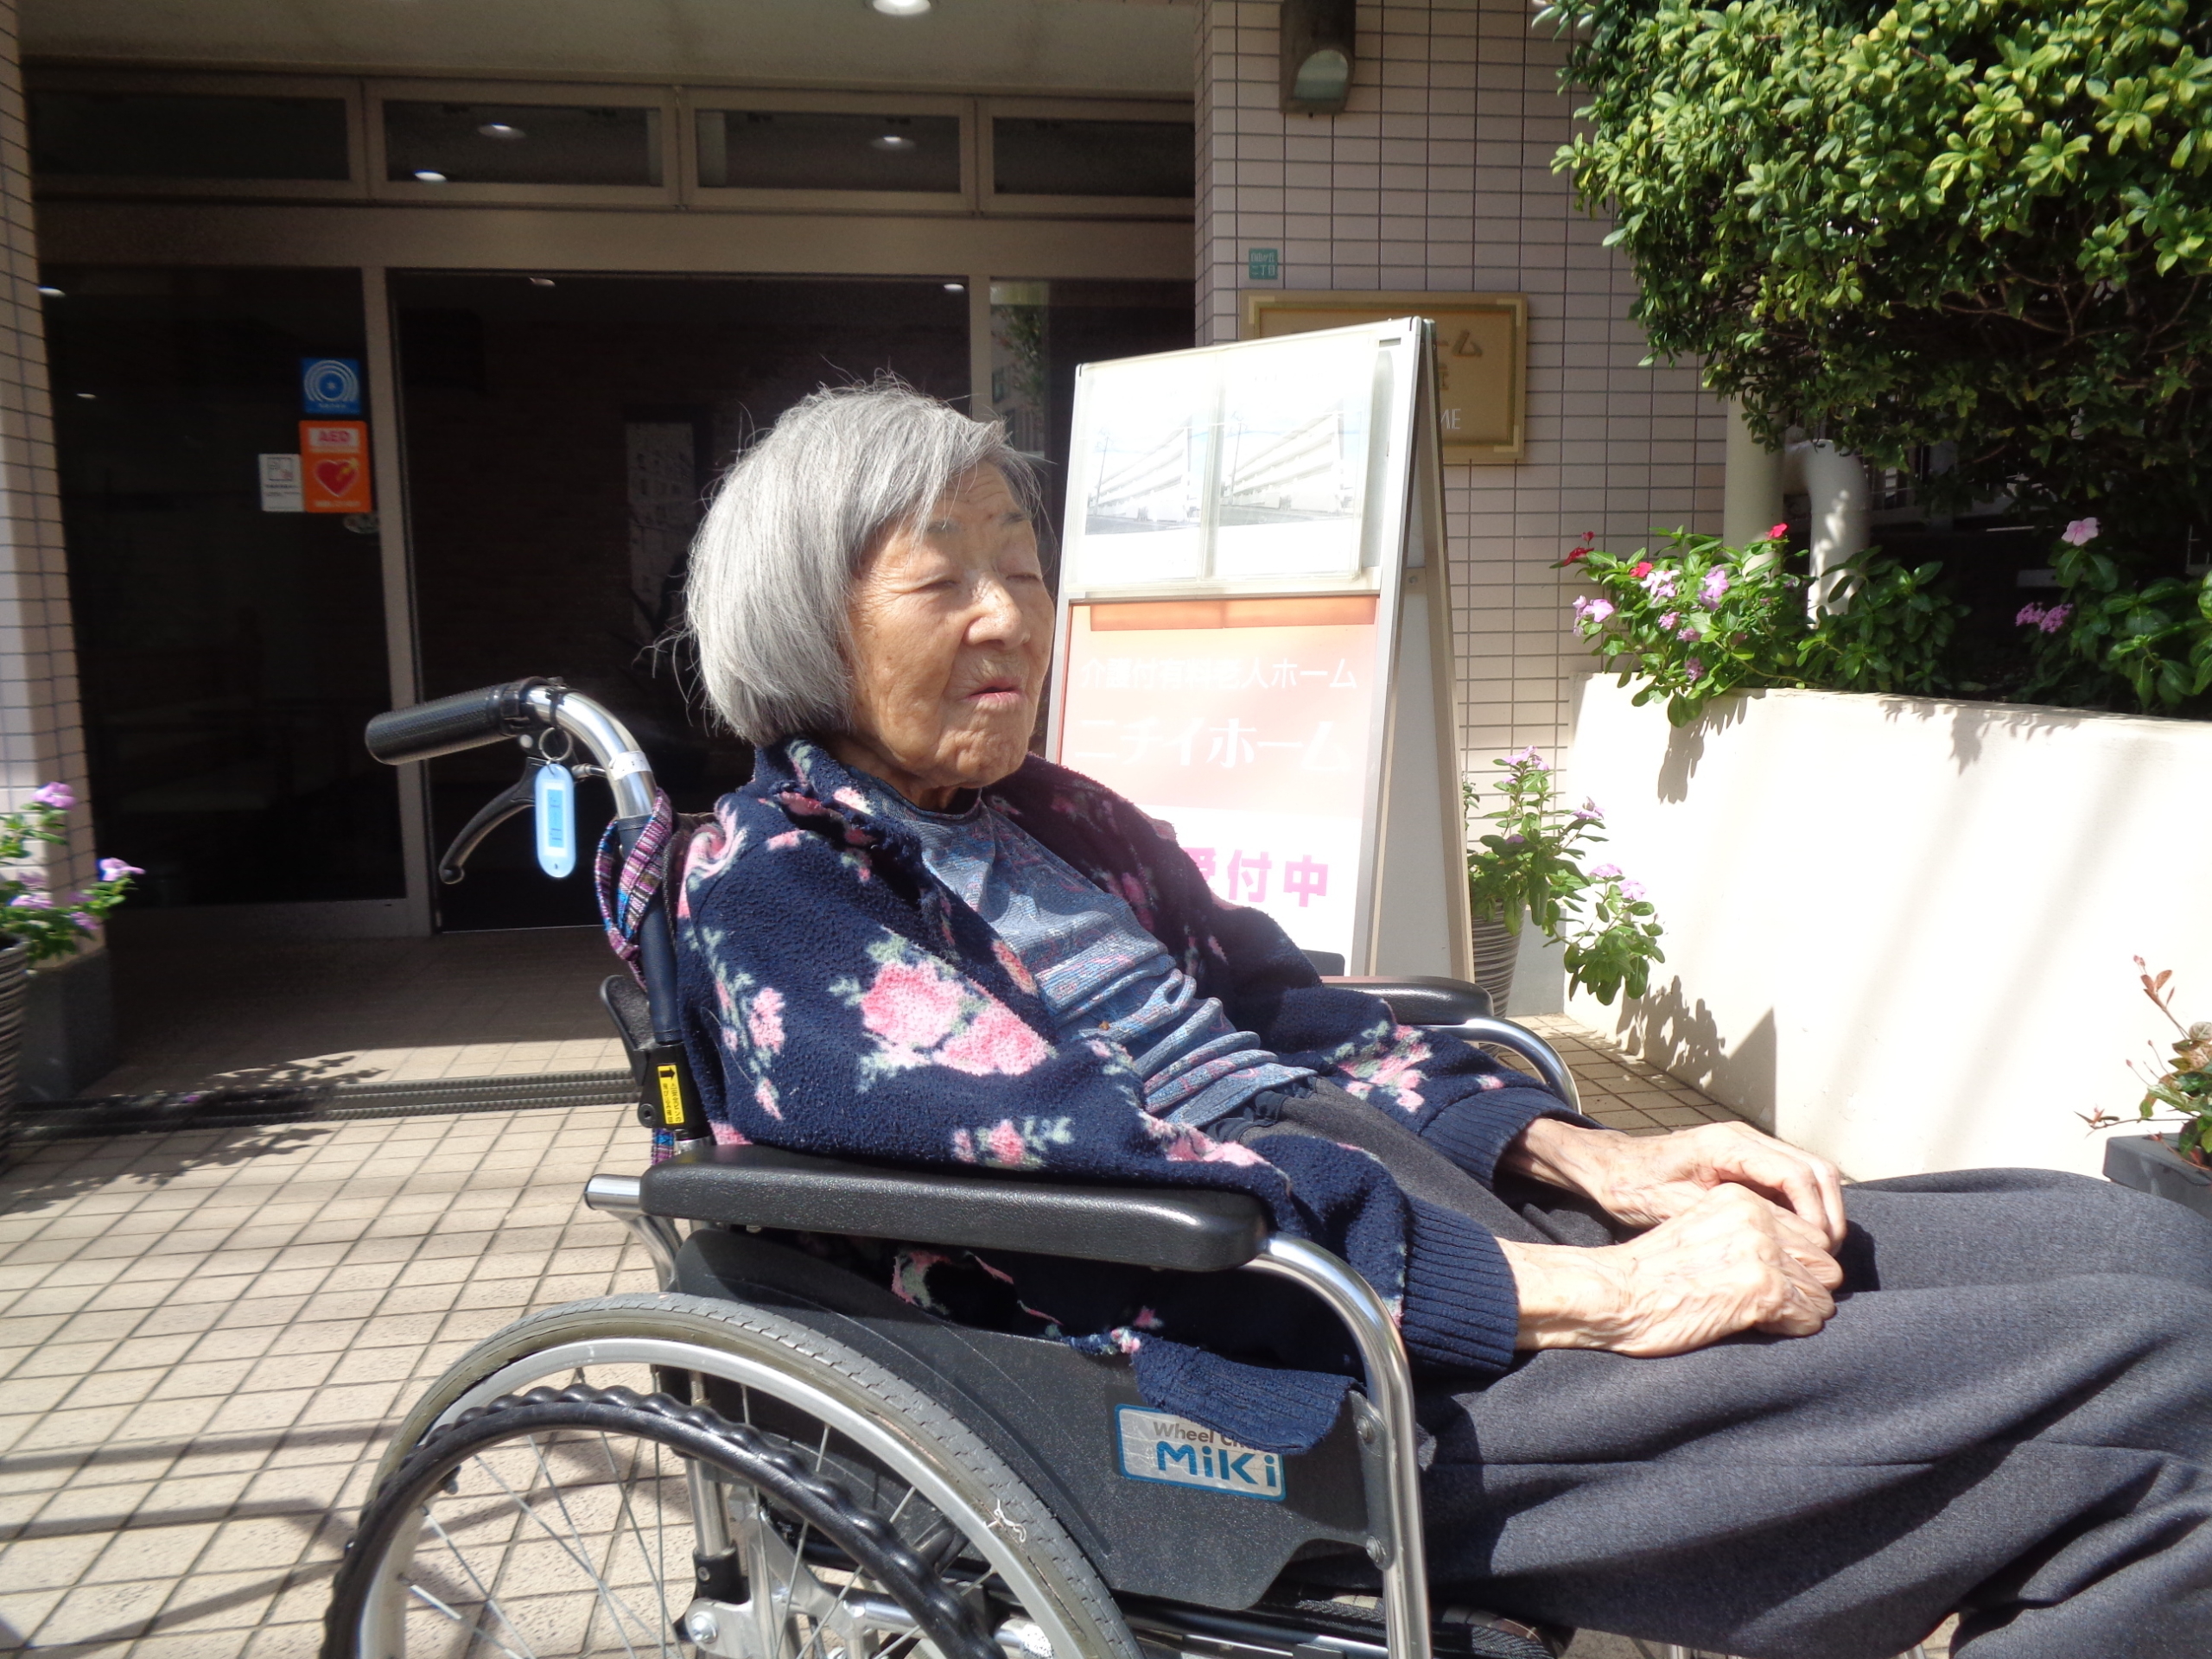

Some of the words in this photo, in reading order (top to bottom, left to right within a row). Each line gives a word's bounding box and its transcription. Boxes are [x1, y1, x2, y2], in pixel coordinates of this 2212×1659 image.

[1251, 264, 1275, 276] 二丁目
[1081, 657, 1357, 690] 介護付有料老人ホーム
[1074, 716, 1353, 772] ニチイホーム
[1153, 1421, 1215, 1444] Wheel
